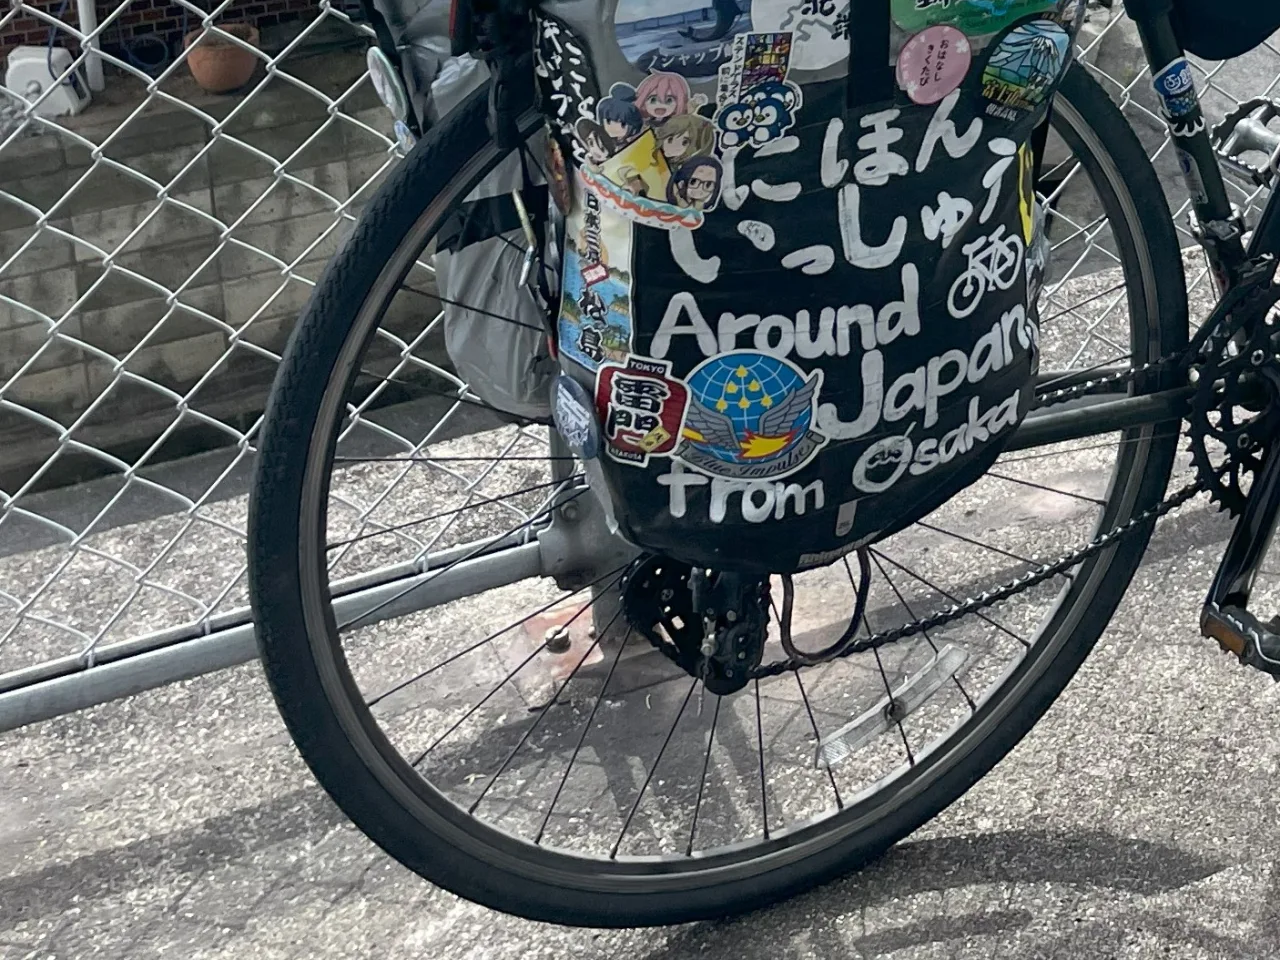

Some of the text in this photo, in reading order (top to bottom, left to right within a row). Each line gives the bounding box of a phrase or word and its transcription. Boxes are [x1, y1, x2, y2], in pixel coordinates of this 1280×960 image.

[919, 44, 934, 86] きくたび
[934, 40, 949, 82] おはなし
[722, 88, 984, 211] にほん
[669, 137, 1017, 284] いっしゅう
[650, 263, 921, 359] Around
[629, 360, 665, 375] TOKYO
[817, 303, 1030, 440] Japan
[735, 442, 813, 477] Impulse
[852, 388, 1021, 493] Osaka
